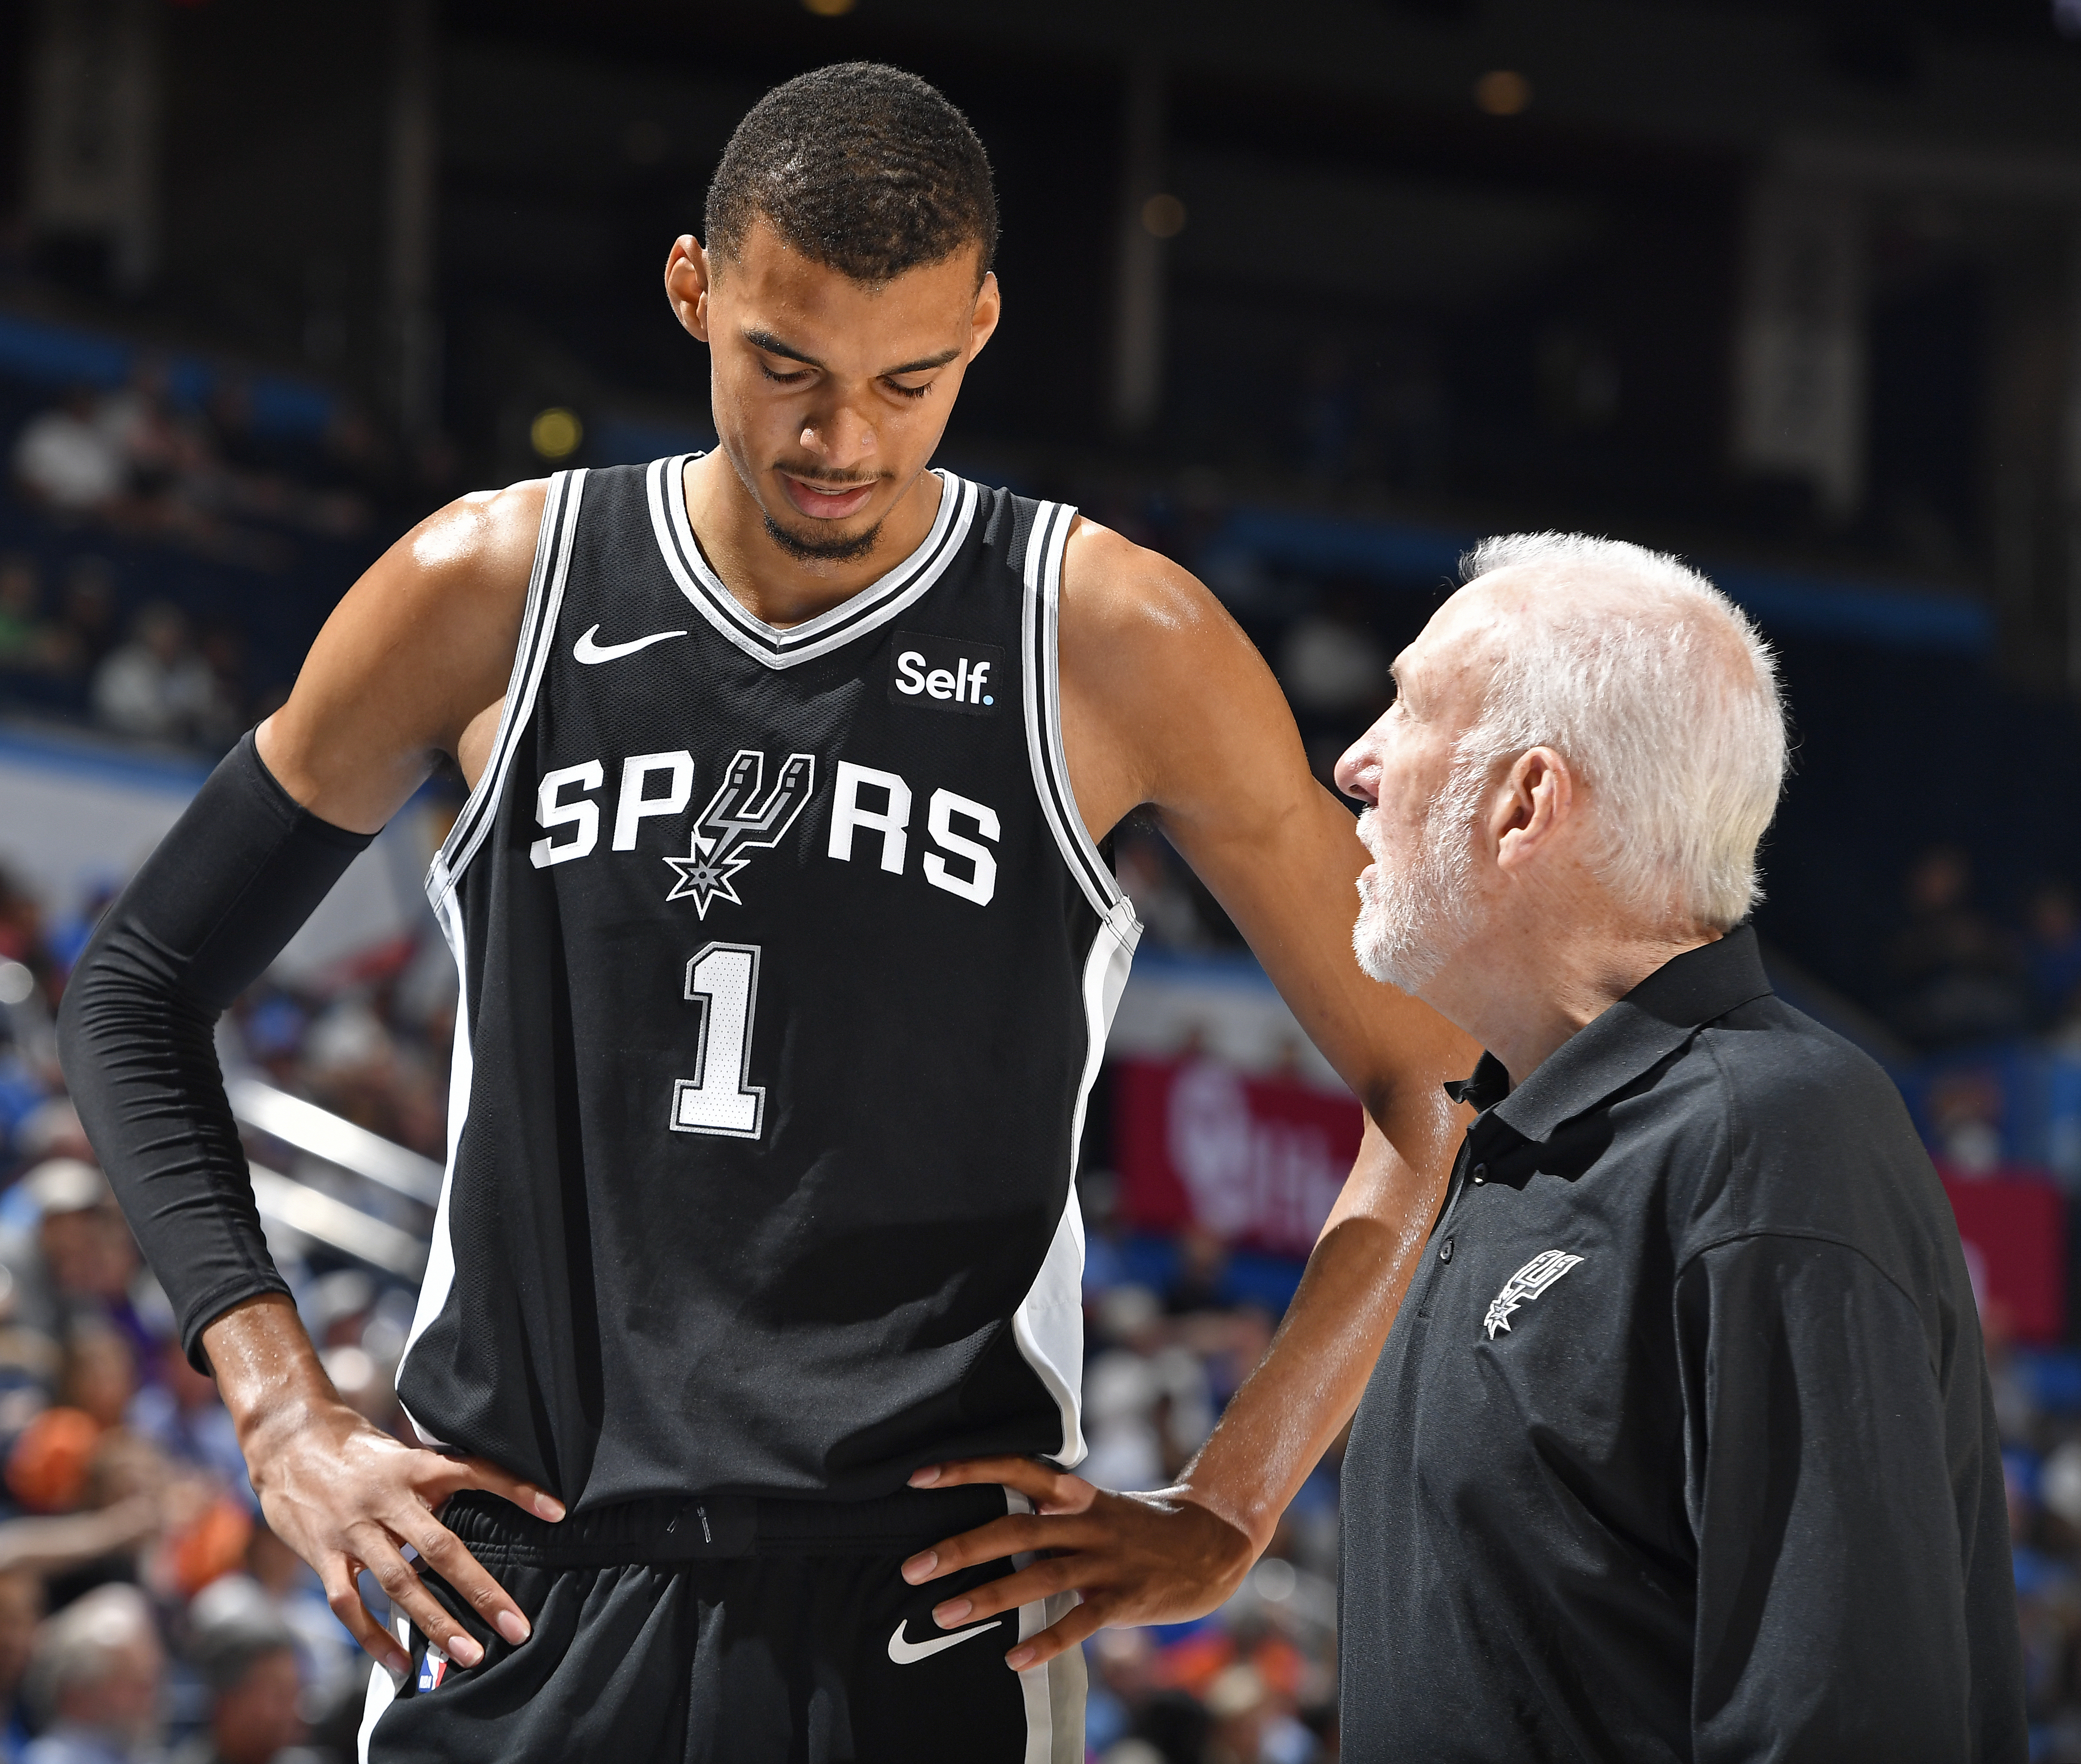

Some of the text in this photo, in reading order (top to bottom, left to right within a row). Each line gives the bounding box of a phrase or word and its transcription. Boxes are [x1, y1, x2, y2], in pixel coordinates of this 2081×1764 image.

[895, 651, 994, 706] Self.
[530, 750, 1001, 920] SPURS
[669, 942, 765, 1140] 1
